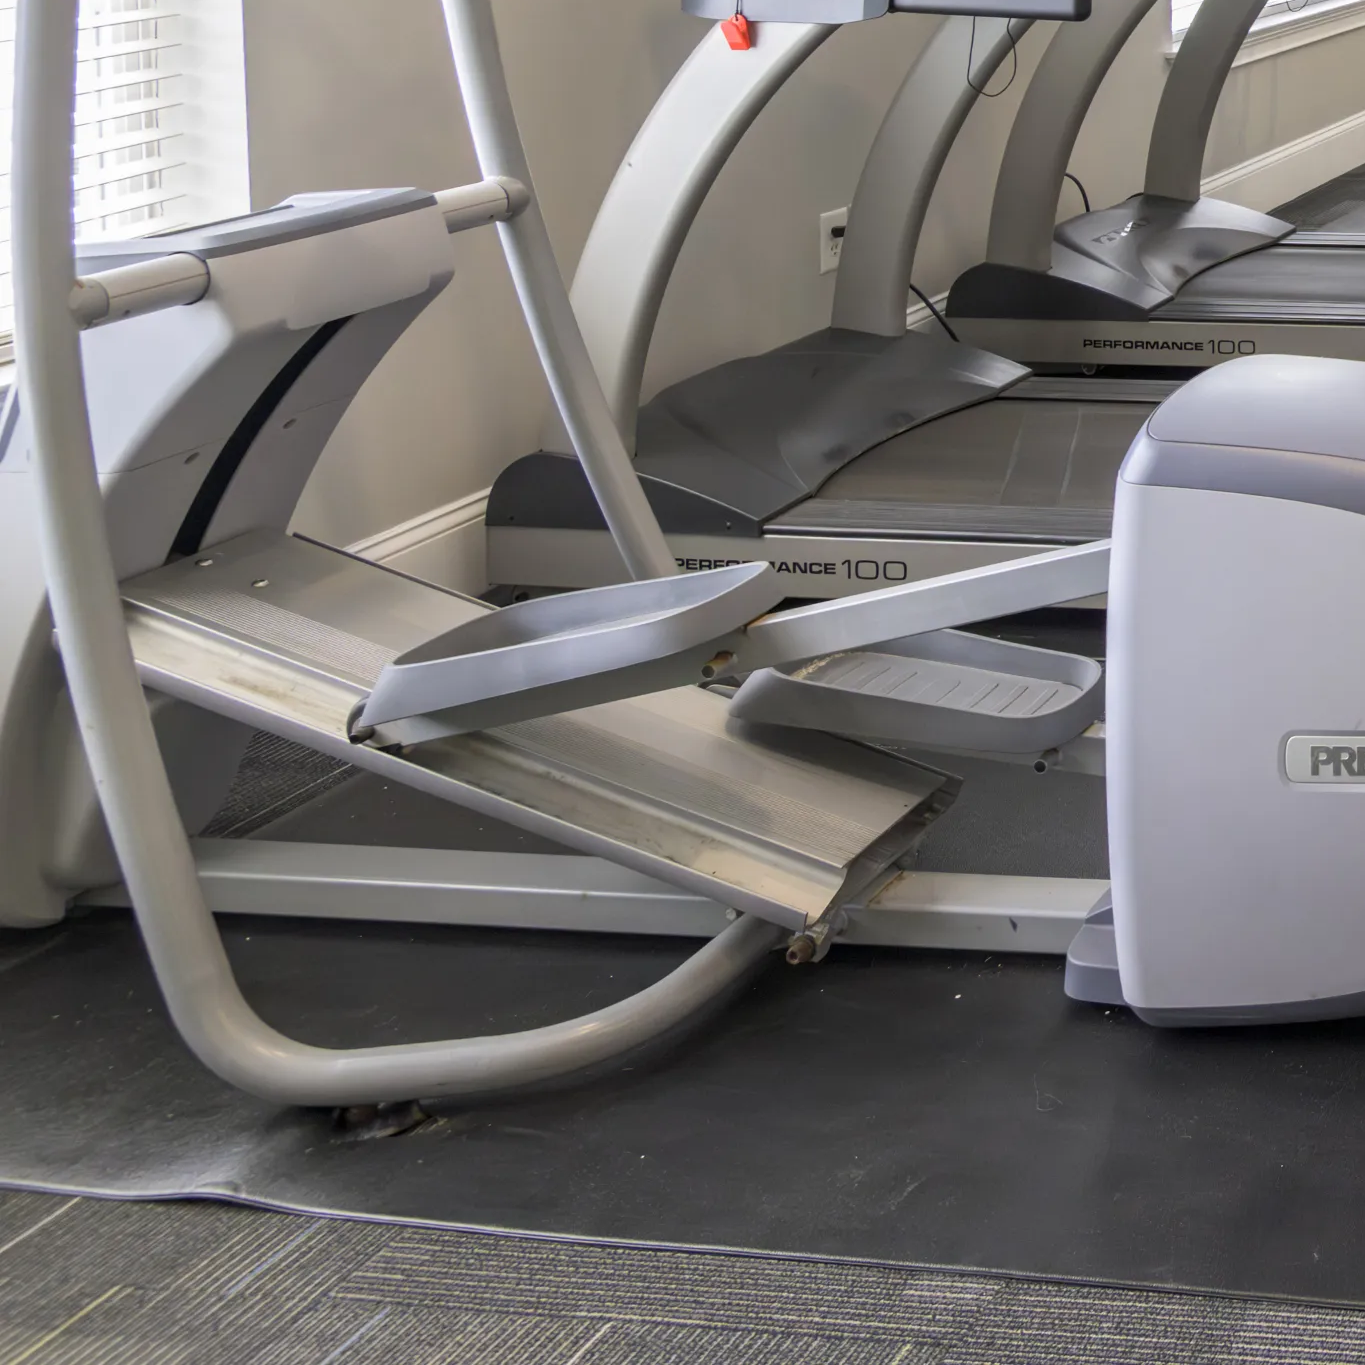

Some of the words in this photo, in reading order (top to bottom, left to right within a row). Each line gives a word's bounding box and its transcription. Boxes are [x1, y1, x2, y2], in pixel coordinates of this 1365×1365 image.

[1083, 338, 1204, 352] PERFORMANCE
[1207, 338, 1256, 355] 100
[674, 557, 837, 575] PERFANCE
[841, 558, 908, 582] 100
